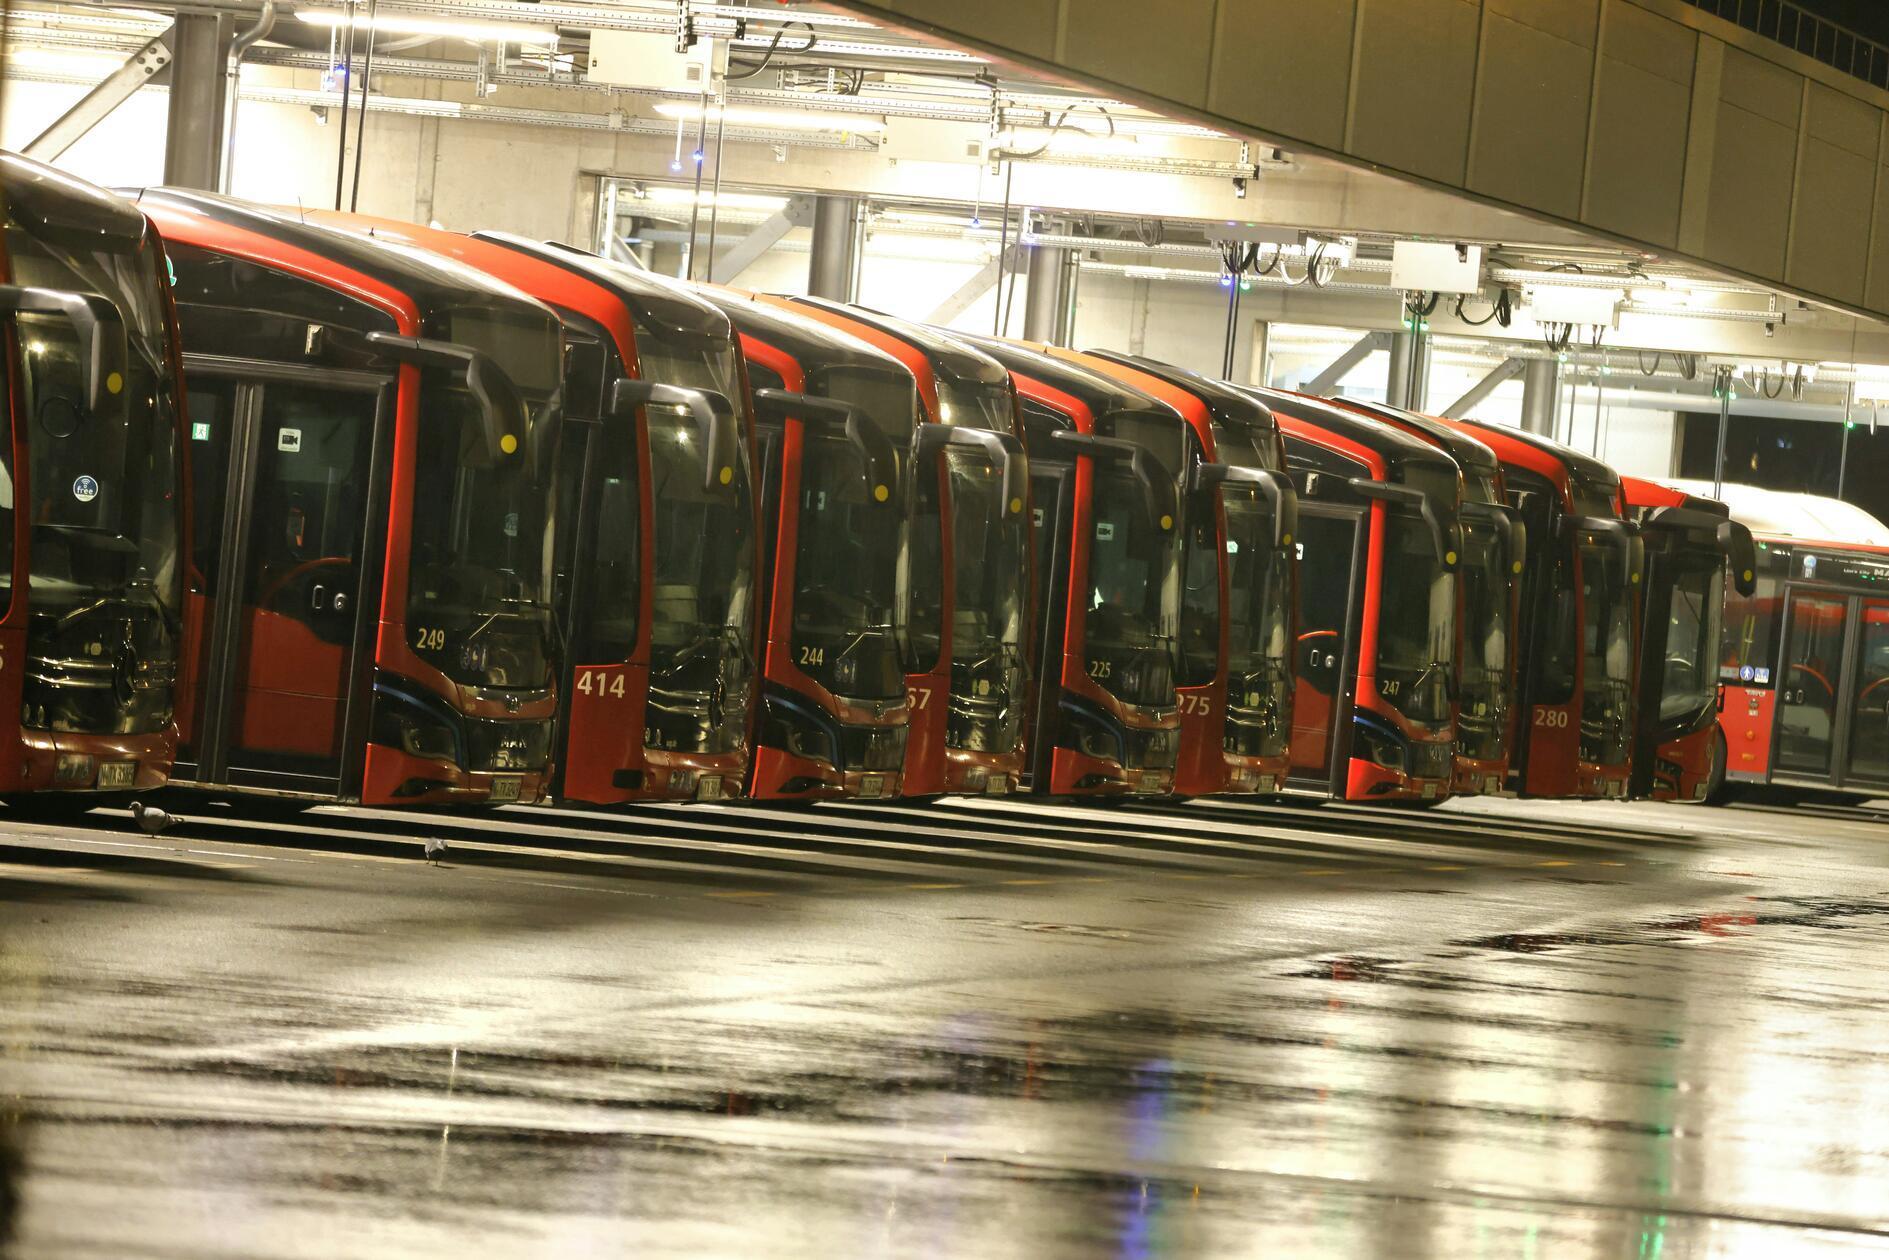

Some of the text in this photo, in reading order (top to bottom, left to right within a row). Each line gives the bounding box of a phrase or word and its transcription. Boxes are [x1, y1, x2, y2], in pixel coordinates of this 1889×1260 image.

[77, 486, 93, 495] free
[416, 628, 445, 650] 249
[800, 646, 823, 666] 244
[1090, 661, 1111, 678] 225
[577, 671, 625, 698] 414
[1382, 680, 1400, 696] 247
[1535, 709, 1568, 728] 280
